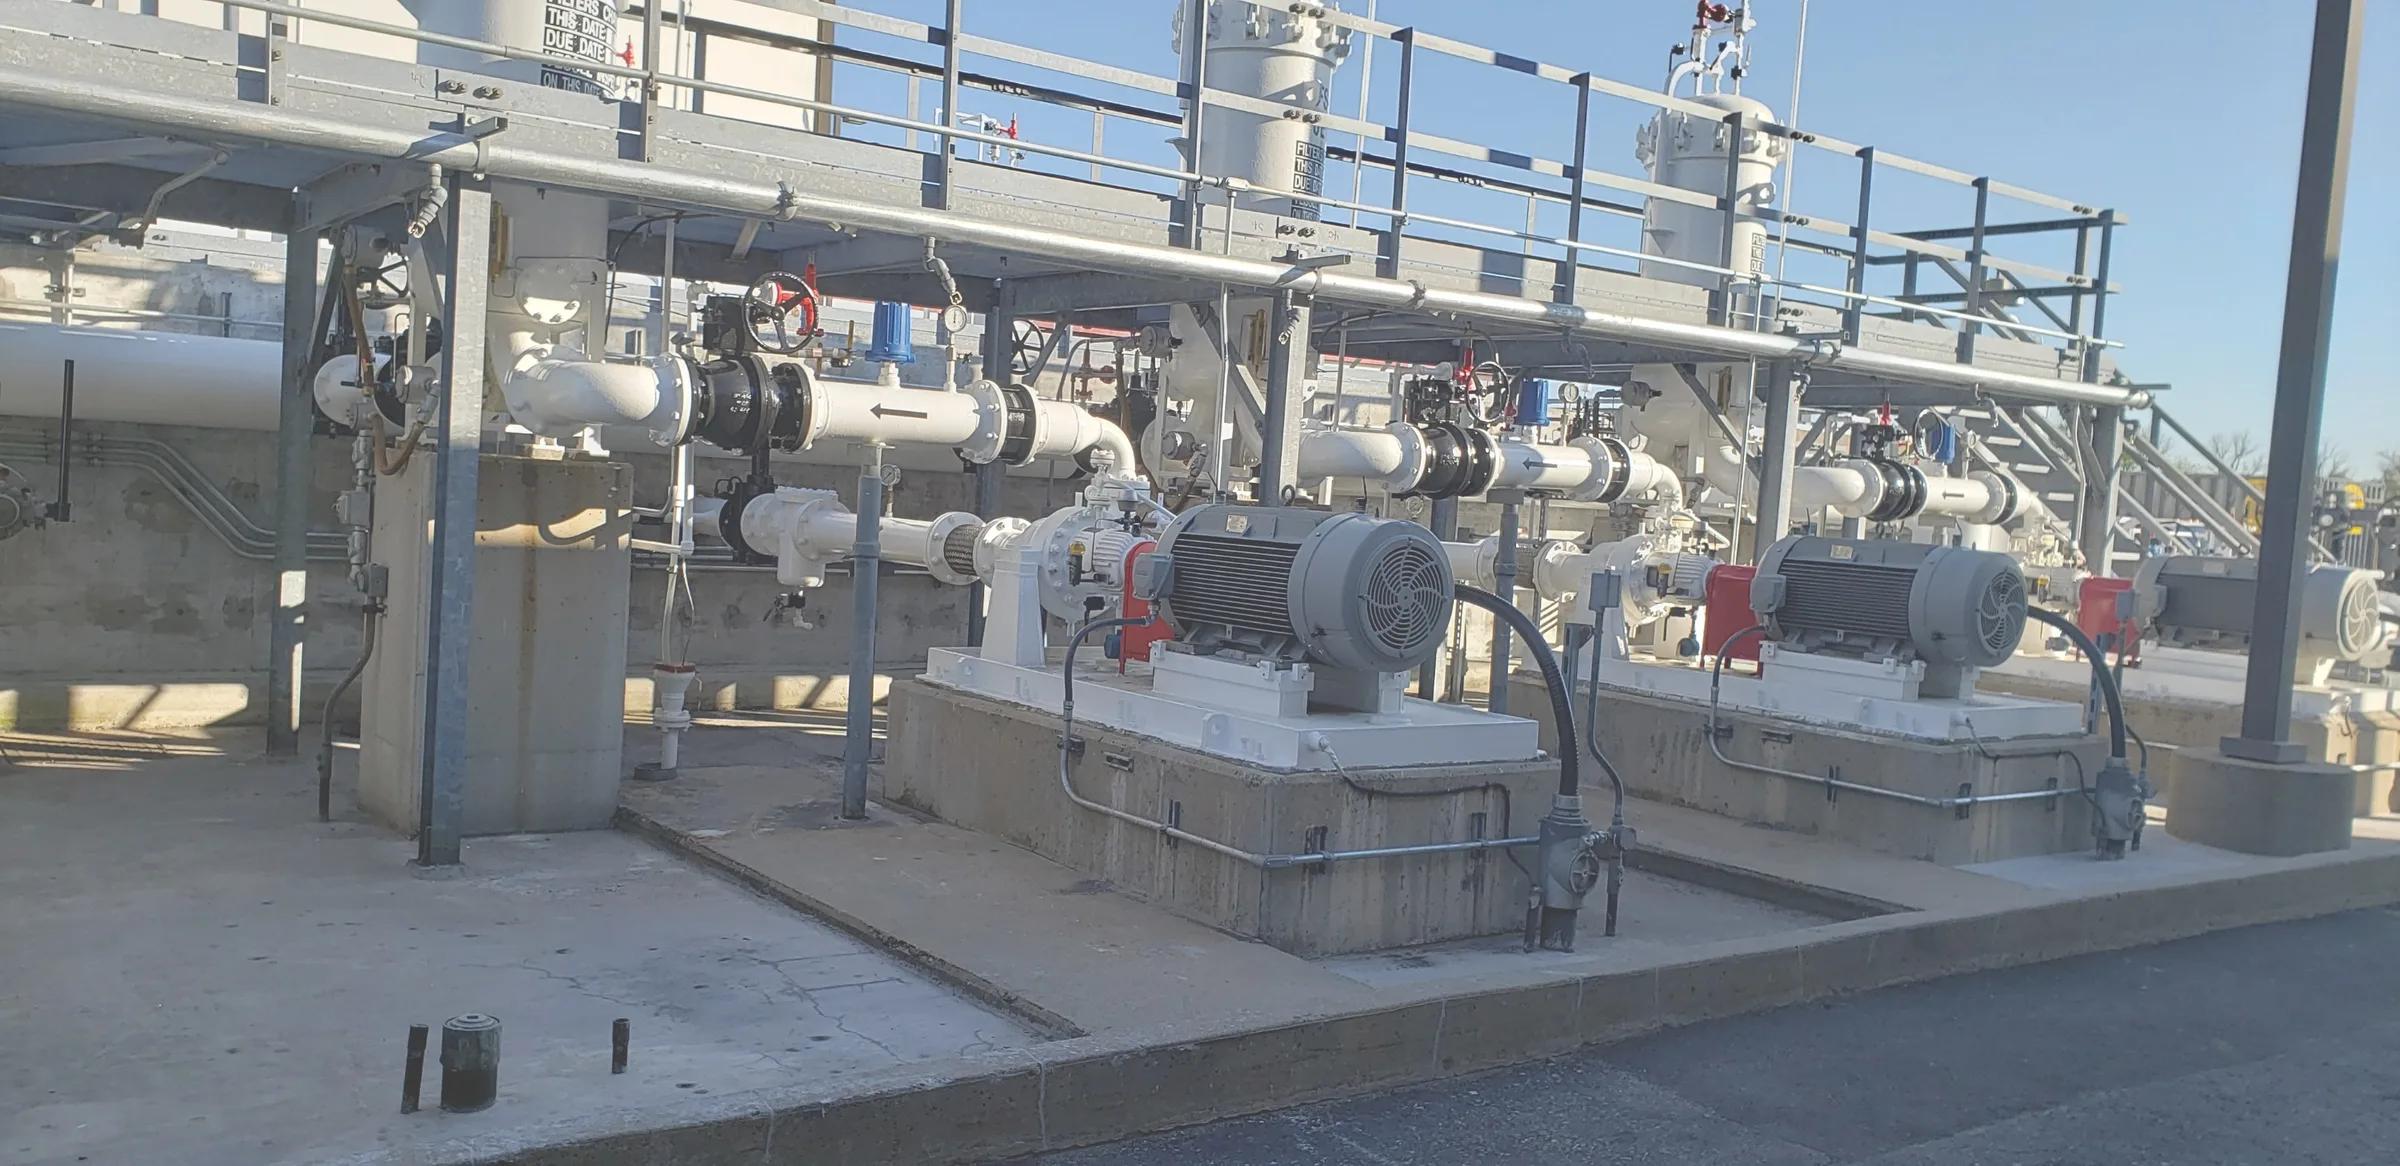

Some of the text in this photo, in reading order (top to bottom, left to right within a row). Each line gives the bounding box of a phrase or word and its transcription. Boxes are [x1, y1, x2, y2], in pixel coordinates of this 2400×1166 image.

[548, 8, 606, 40] THIS DATE
[545, 29, 606, 61] DUE DATE
[543, 72, 558, 89] ON
[562, 76, 581, 92] THIS
[1297, 158, 1313, 175] THIS
[1294, 174, 1311, 191] DUE
